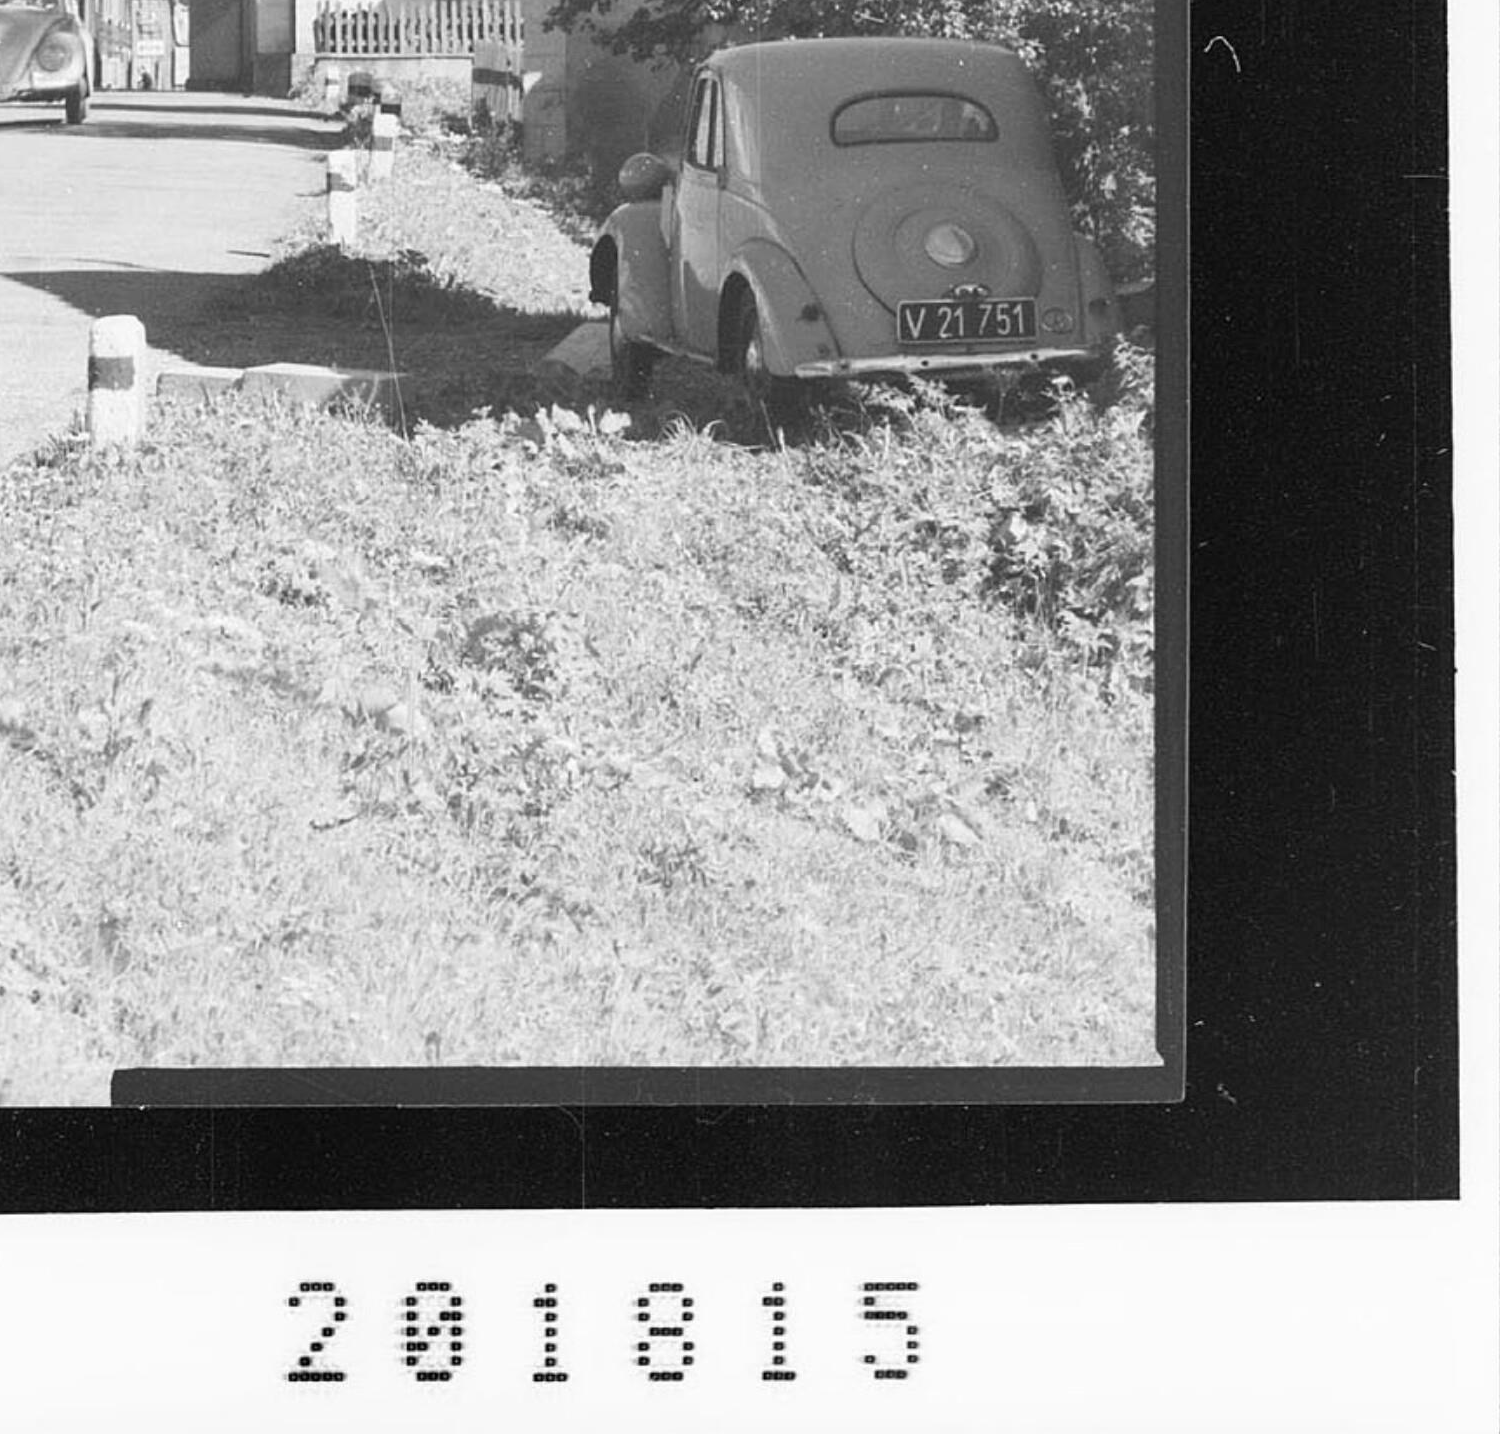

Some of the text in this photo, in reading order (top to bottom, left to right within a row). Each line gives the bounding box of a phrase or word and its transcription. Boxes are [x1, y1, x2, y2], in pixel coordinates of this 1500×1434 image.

[905, 303, 1026, 339] V 21 751
